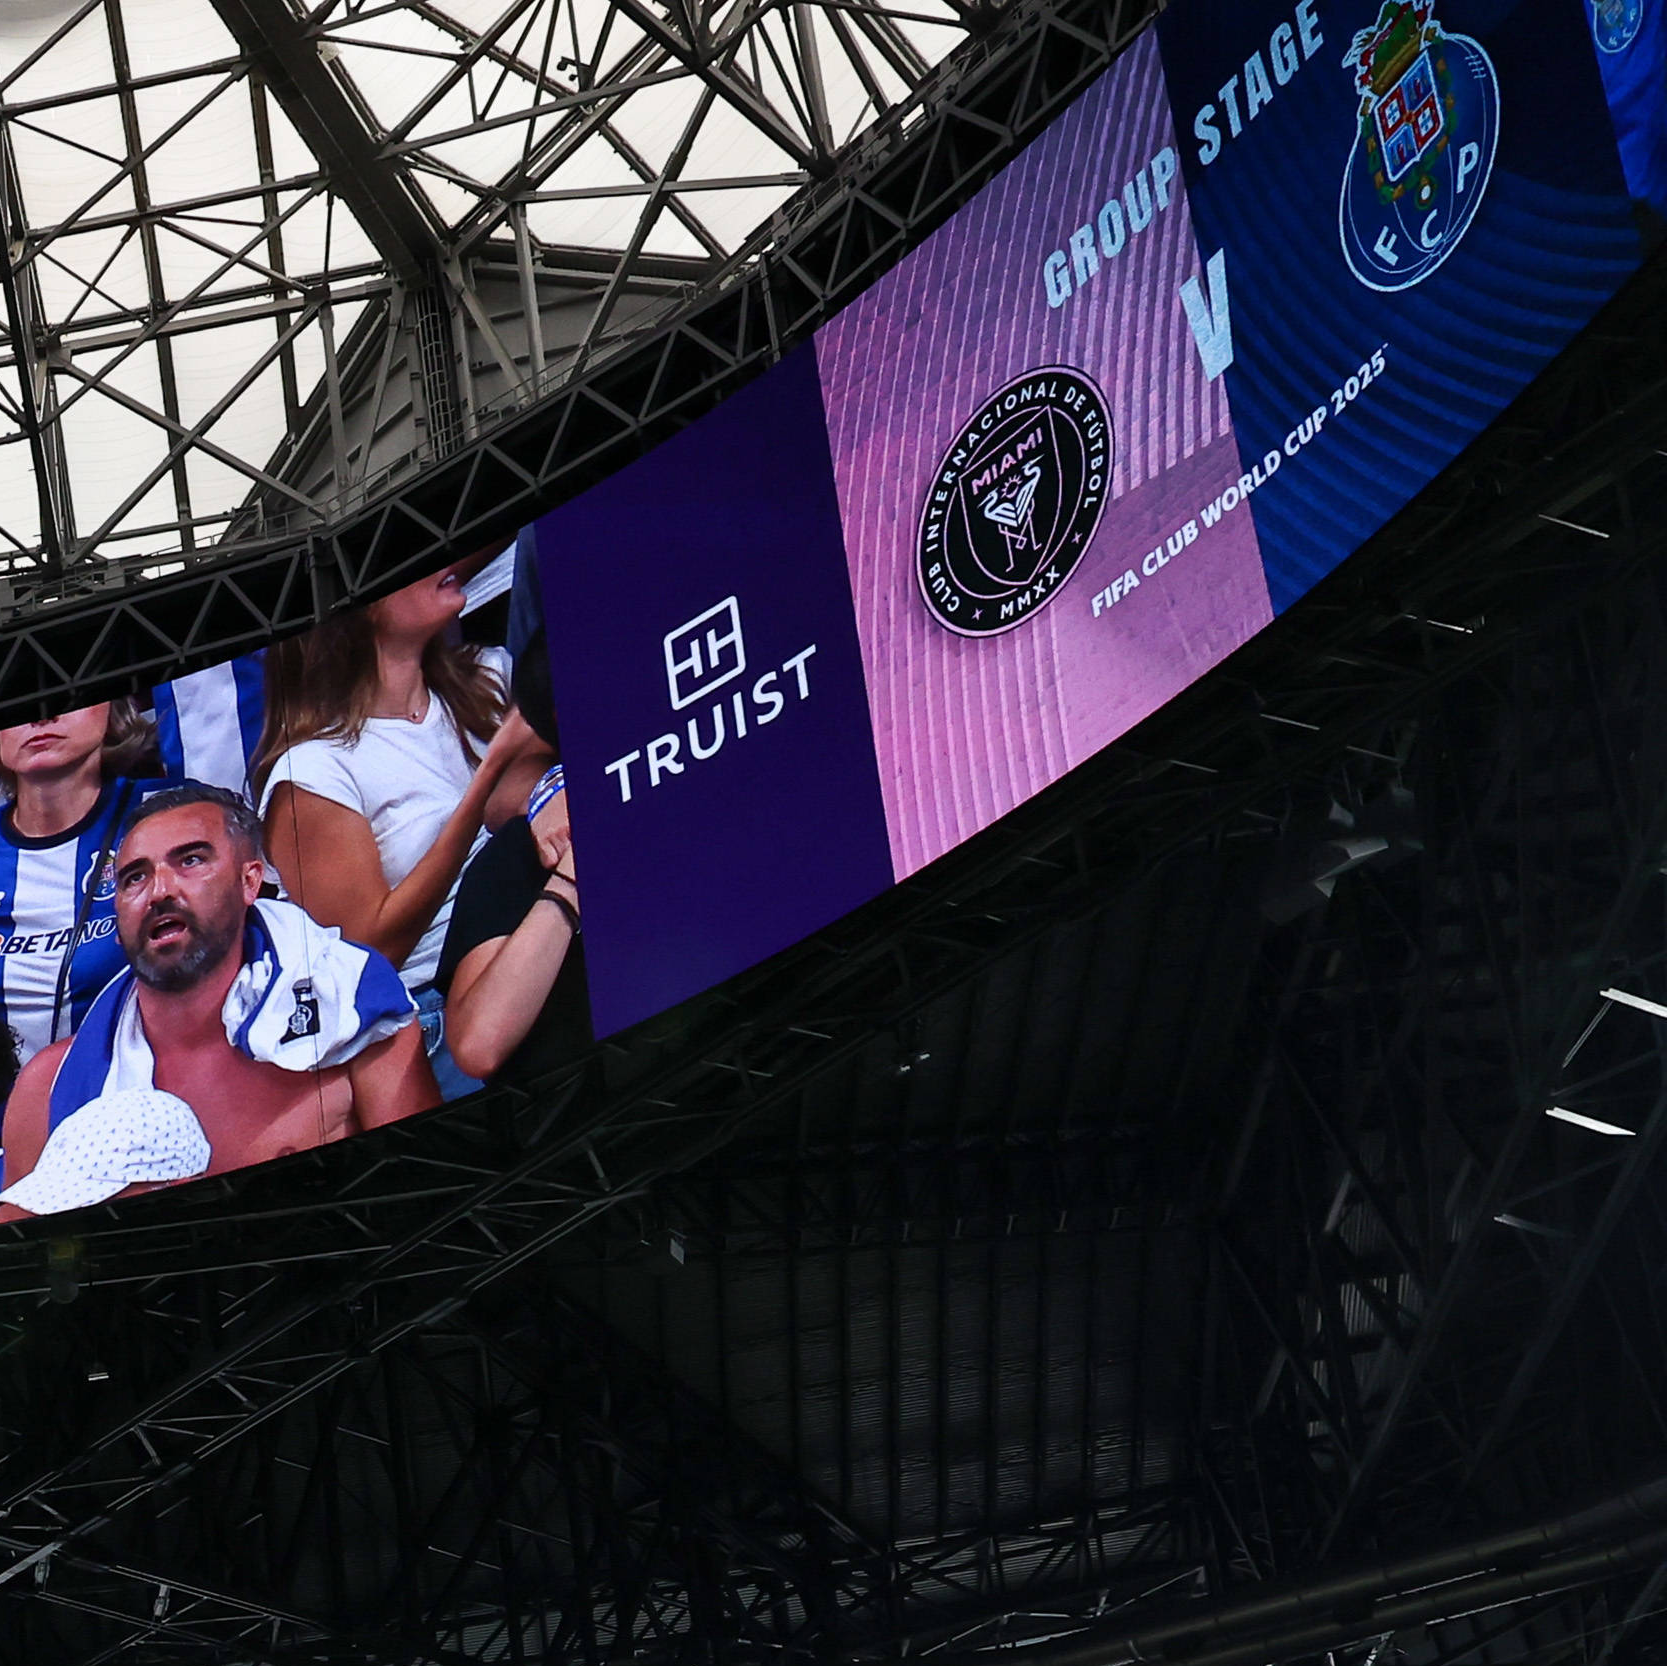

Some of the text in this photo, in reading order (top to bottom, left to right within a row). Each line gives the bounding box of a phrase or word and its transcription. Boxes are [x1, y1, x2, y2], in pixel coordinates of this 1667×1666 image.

[1043, 0, 1324, 309] GROUP STAGE
[1178, 247, 1234, 383] V
[925, 380, 1058, 553] INTERNACIONAL
[971, 427, 1044, 496] MIAMI
[1064, 385, 1087, 413] DE
[1090, 568, 1141, 619] FIFA
[1141, 518, 1200, 578] CLUB
[1199, 449, 1282, 529] WORLD
[1283, 405, 1328, 458] CUP
[928, 561, 961, 612] CLUB
[1000, 565, 1061, 620] MMXX
[604, 643, 817, 803] TRUIST
